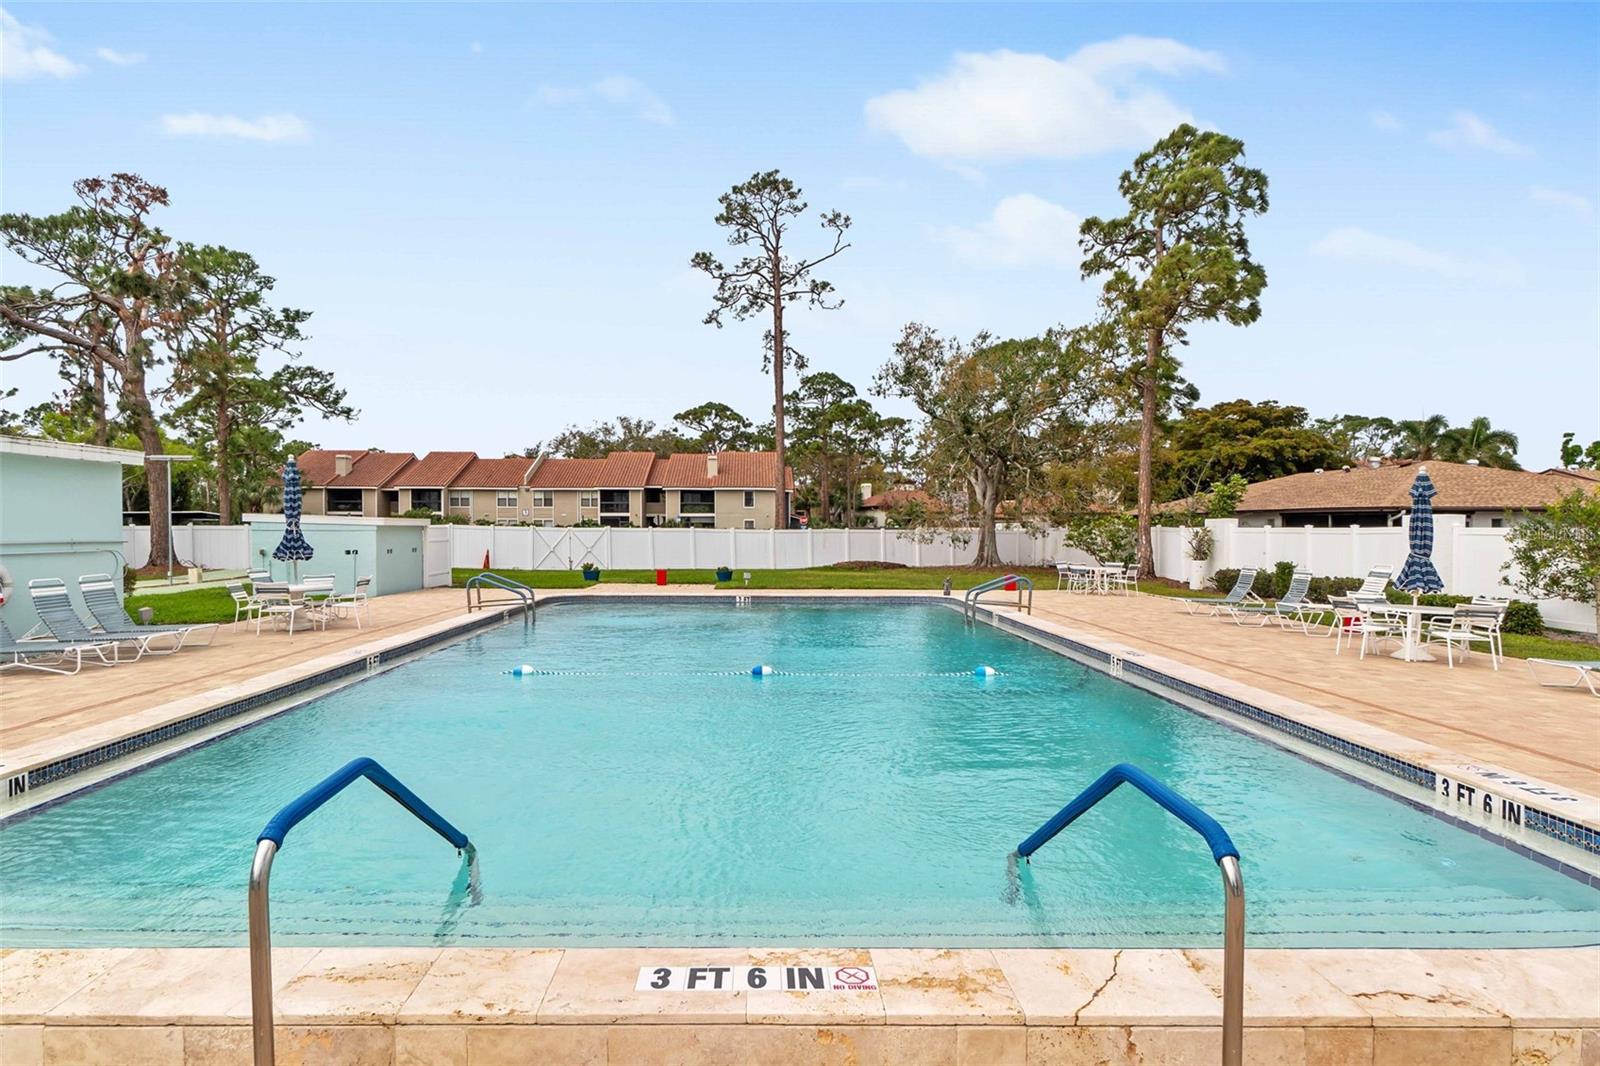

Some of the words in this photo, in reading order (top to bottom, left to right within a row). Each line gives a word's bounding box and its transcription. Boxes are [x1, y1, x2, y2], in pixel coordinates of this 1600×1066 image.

[8, 774, 26, 798] IN
[1441, 778, 1450, 798] 3
[1457, 782, 1476, 807] FT
[1483, 793, 1493, 814] 6
[1502, 799, 1521, 826] IN
[650, 967, 673, 990] 3
[686, 967, 731, 990] FT
[747, 966, 768, 990] 6
[786, 967, 826, 990] IN
